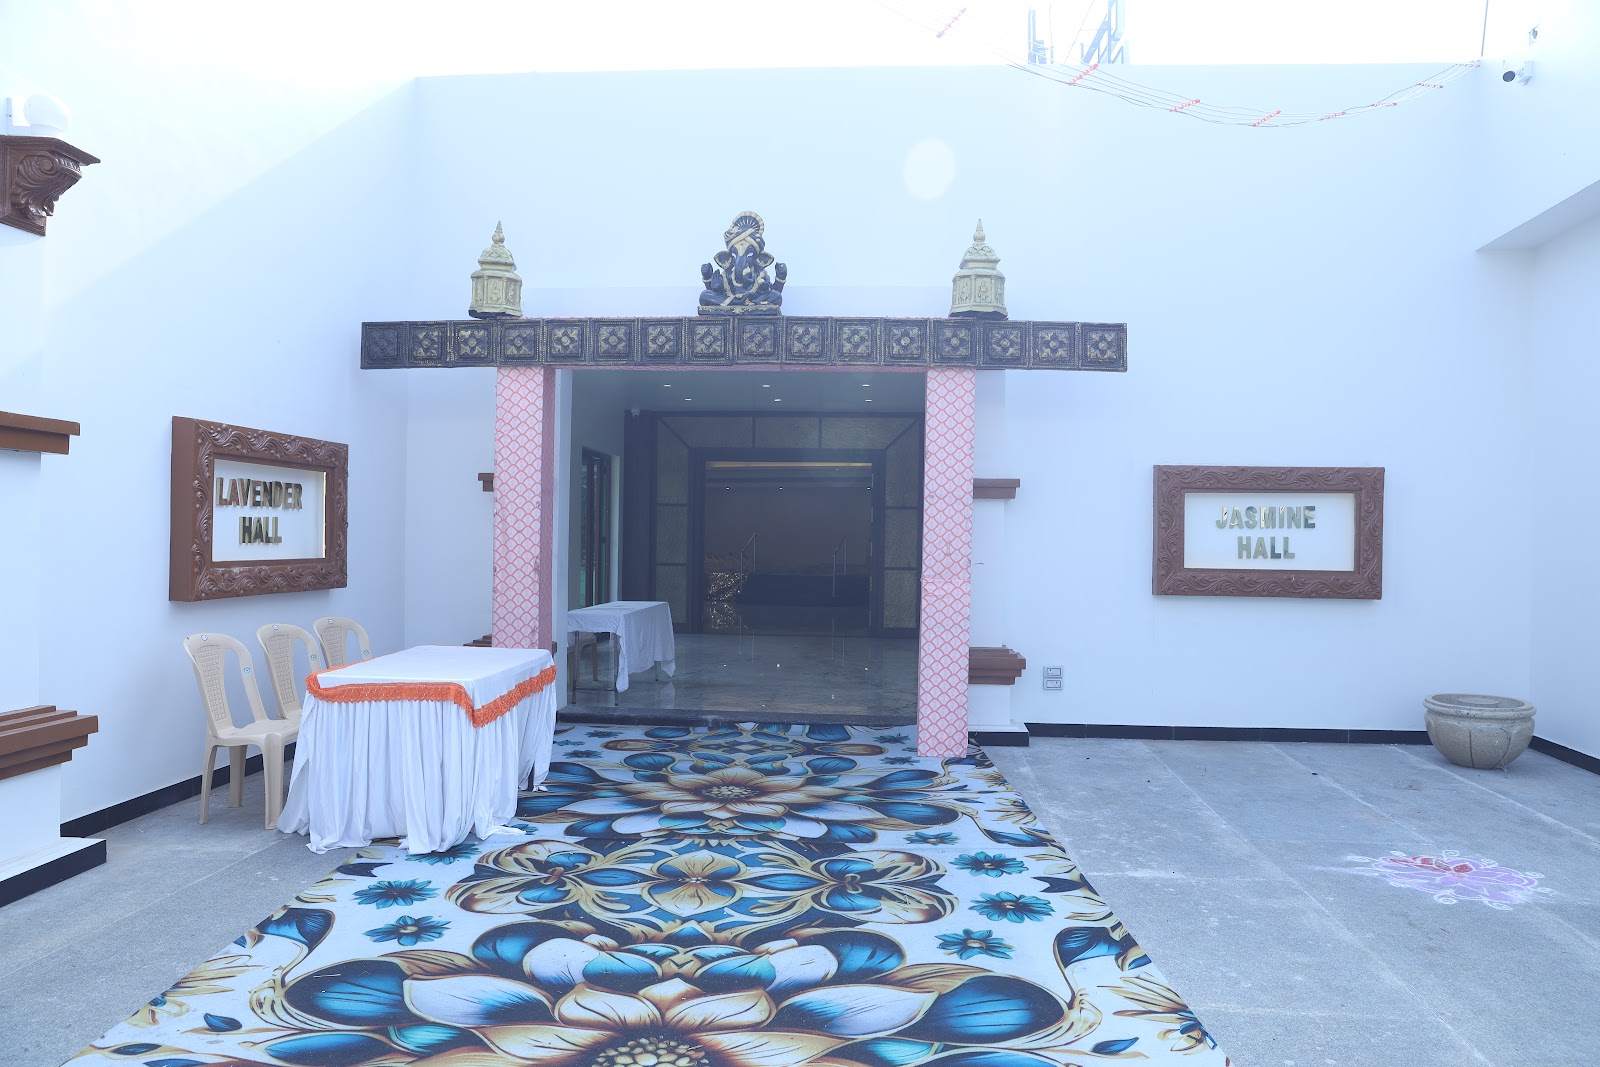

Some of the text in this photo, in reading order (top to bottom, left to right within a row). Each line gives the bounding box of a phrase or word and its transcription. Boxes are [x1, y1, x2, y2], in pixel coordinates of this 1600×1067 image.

[216, 477, 303, 509] LAVENDER
[239, 516, 282, 544] HALL
[1216, 505, 1316, 529] JASMINE
[1237, 536, 1296, 559] HALL
